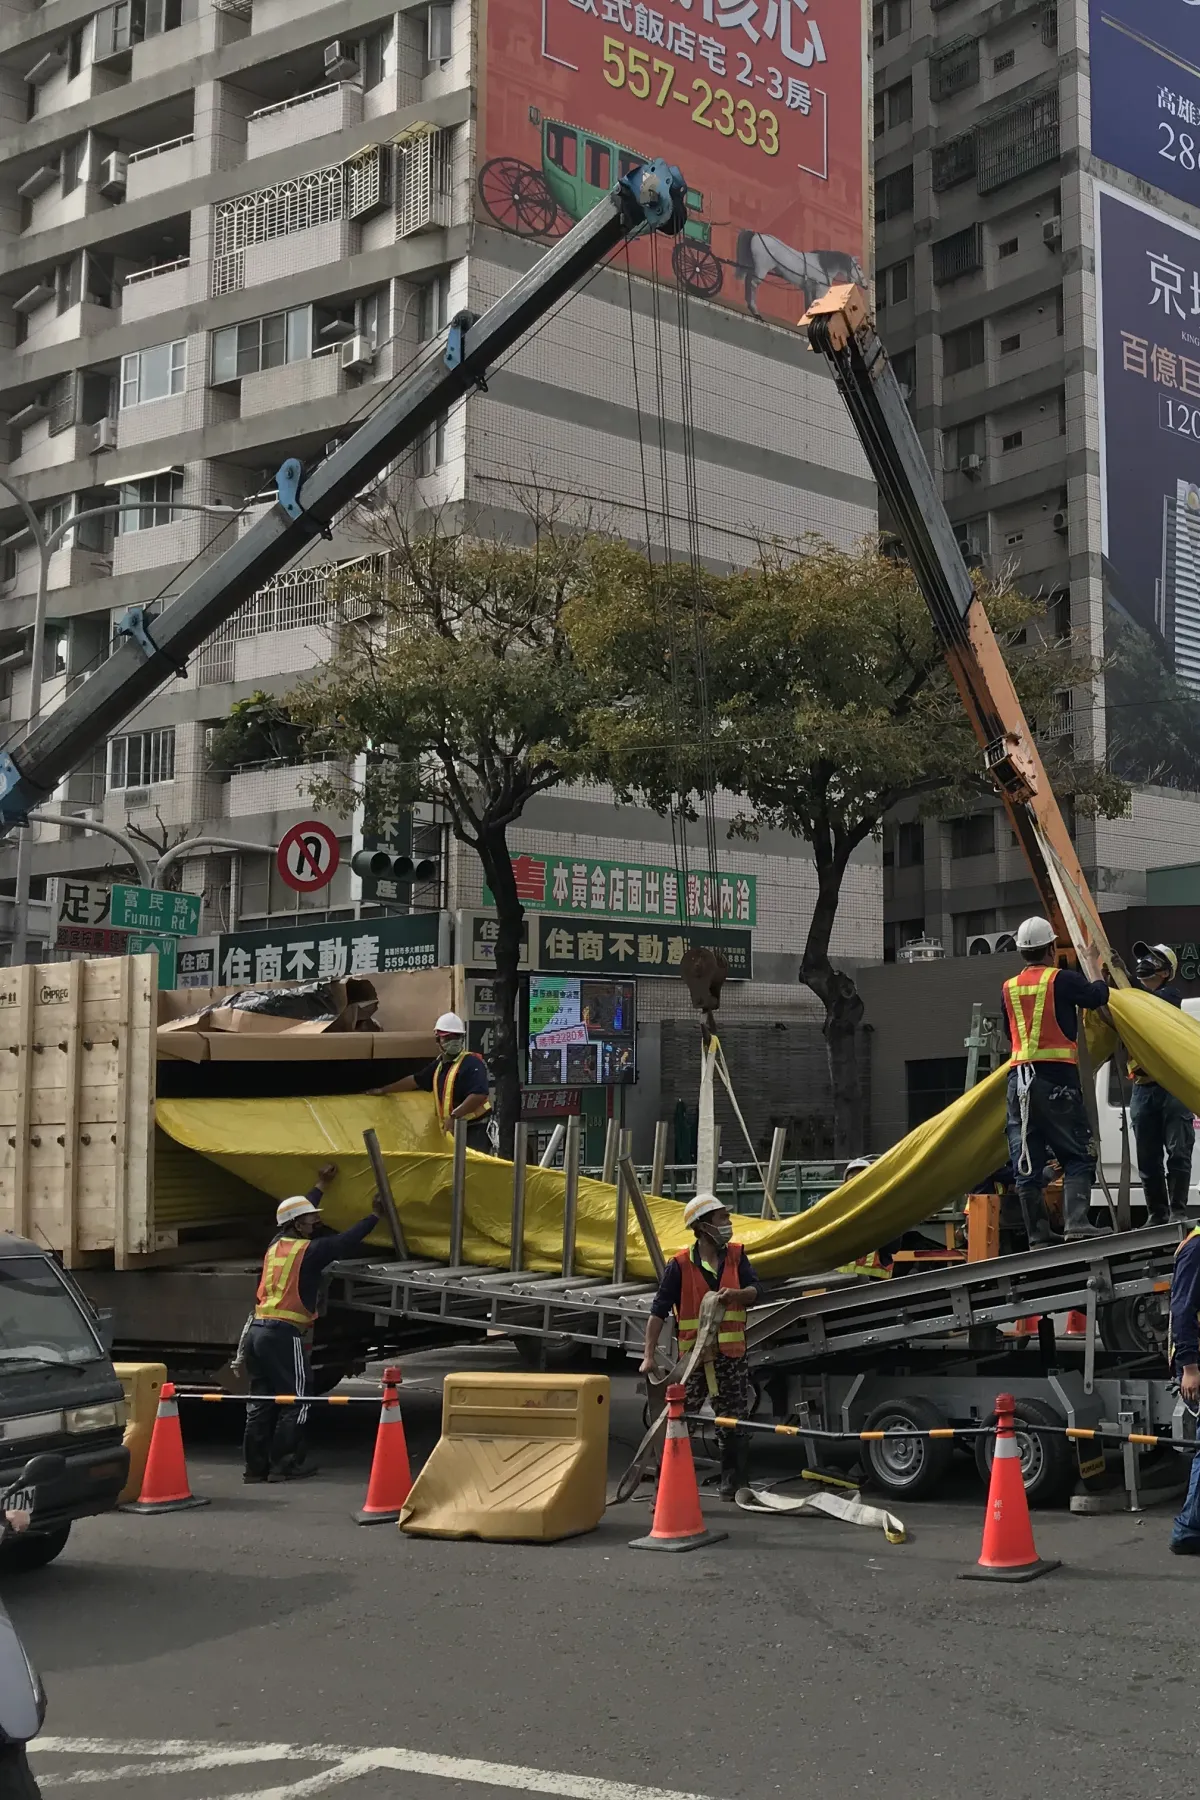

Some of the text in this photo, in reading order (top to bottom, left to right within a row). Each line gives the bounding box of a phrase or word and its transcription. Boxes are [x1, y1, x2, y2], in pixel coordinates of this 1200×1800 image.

[568, 0, 726, 76] 式飯店宅
[602, 35, 780, 156] 557-2333
[124, 889, 189, 914] 富民路
[124, 909, 161, 927] Fumin
[162, 940, 172, 955] W
[222, 934, 380, 986] 住商不動產
[181, 951, 210, 972] 住商
